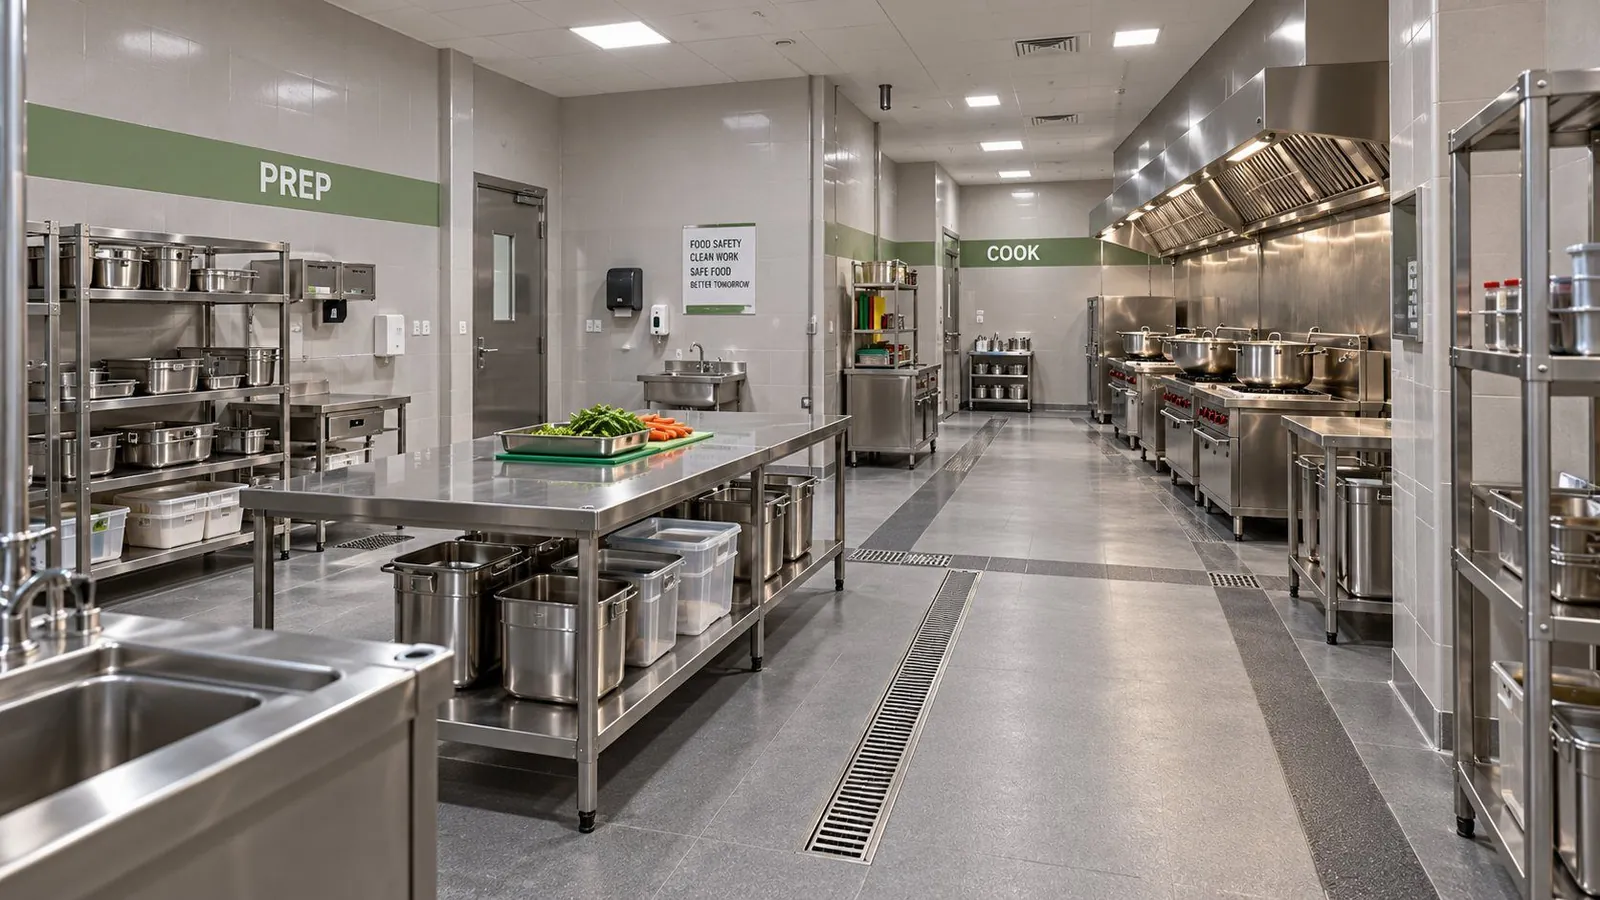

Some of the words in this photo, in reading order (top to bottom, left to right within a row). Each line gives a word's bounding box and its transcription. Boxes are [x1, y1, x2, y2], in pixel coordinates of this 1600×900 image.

[260, 161, 332, 201] PREP
[690, 240, 711, 249] FOOD
[713, 239, 742, 248] SAFETY
[690, 252, 714, 262] CLEAN
[716, 252, 739, 261] WORK
[987, 245, 1040, 261] COOK
[690, 267, 708, 276] SAFE
[711, 267, 731, 276] FOOD
[714, 280, 750, 288] TOMORROW
